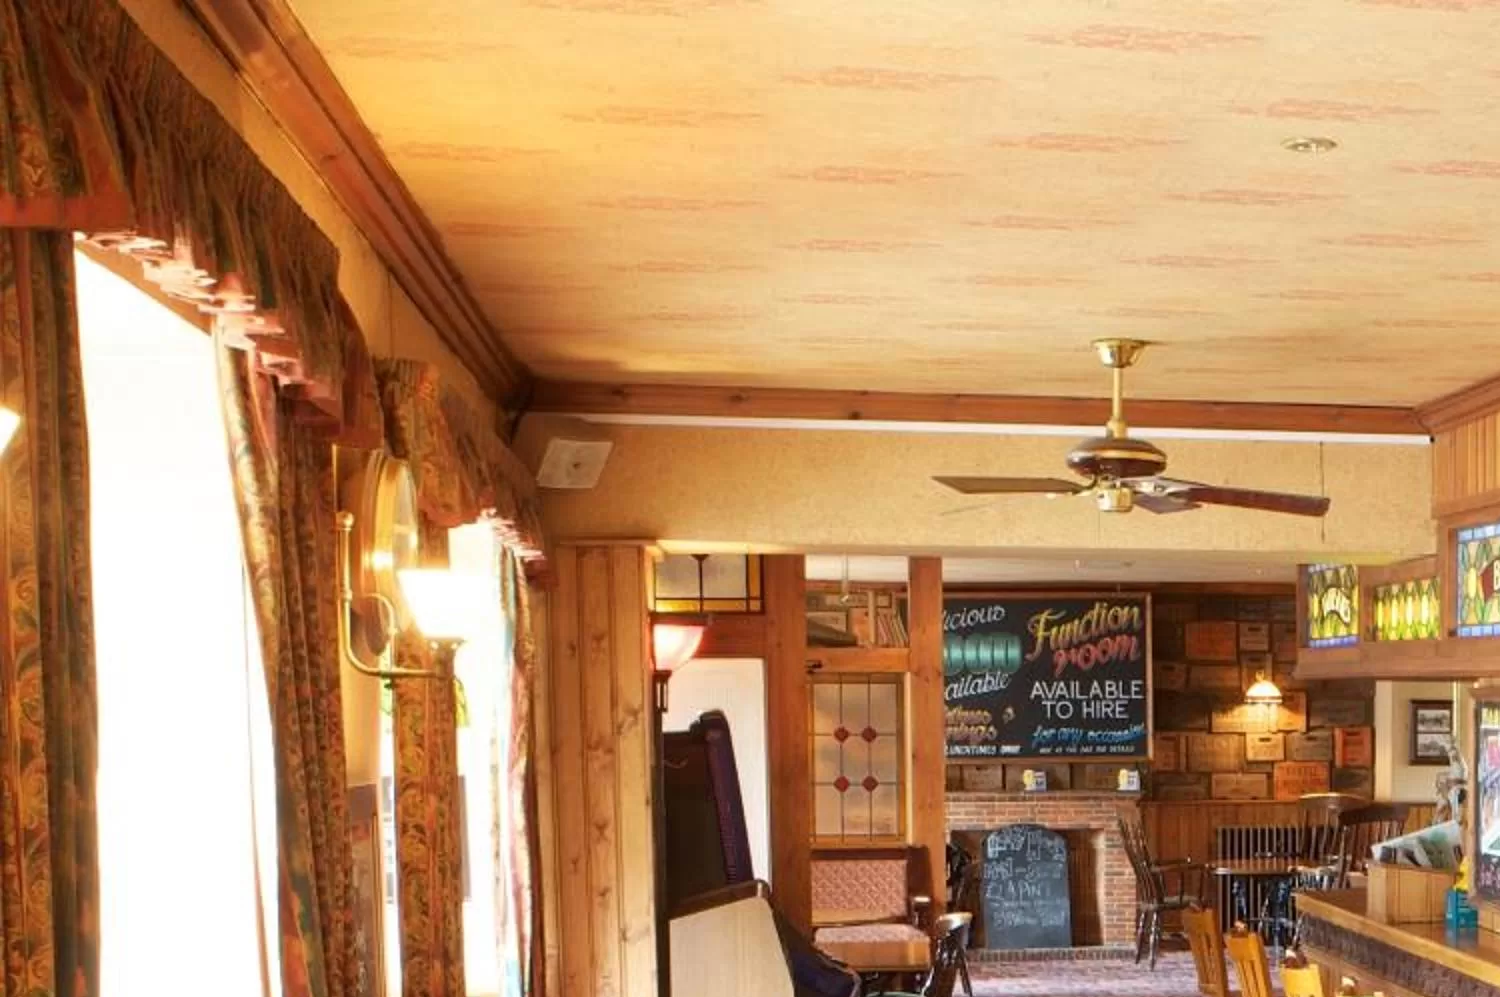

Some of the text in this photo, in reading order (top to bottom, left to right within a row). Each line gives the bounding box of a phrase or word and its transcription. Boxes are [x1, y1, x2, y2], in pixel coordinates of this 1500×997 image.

[943, 605, 1006, 631] icious
[1024, 601, 1141, 661] Function
[945, 669, 1012, 701] ailable
[1029, 680, 1144, 699] AVAILABLE
[1042, 700, 1129, 719] TO HIRE
